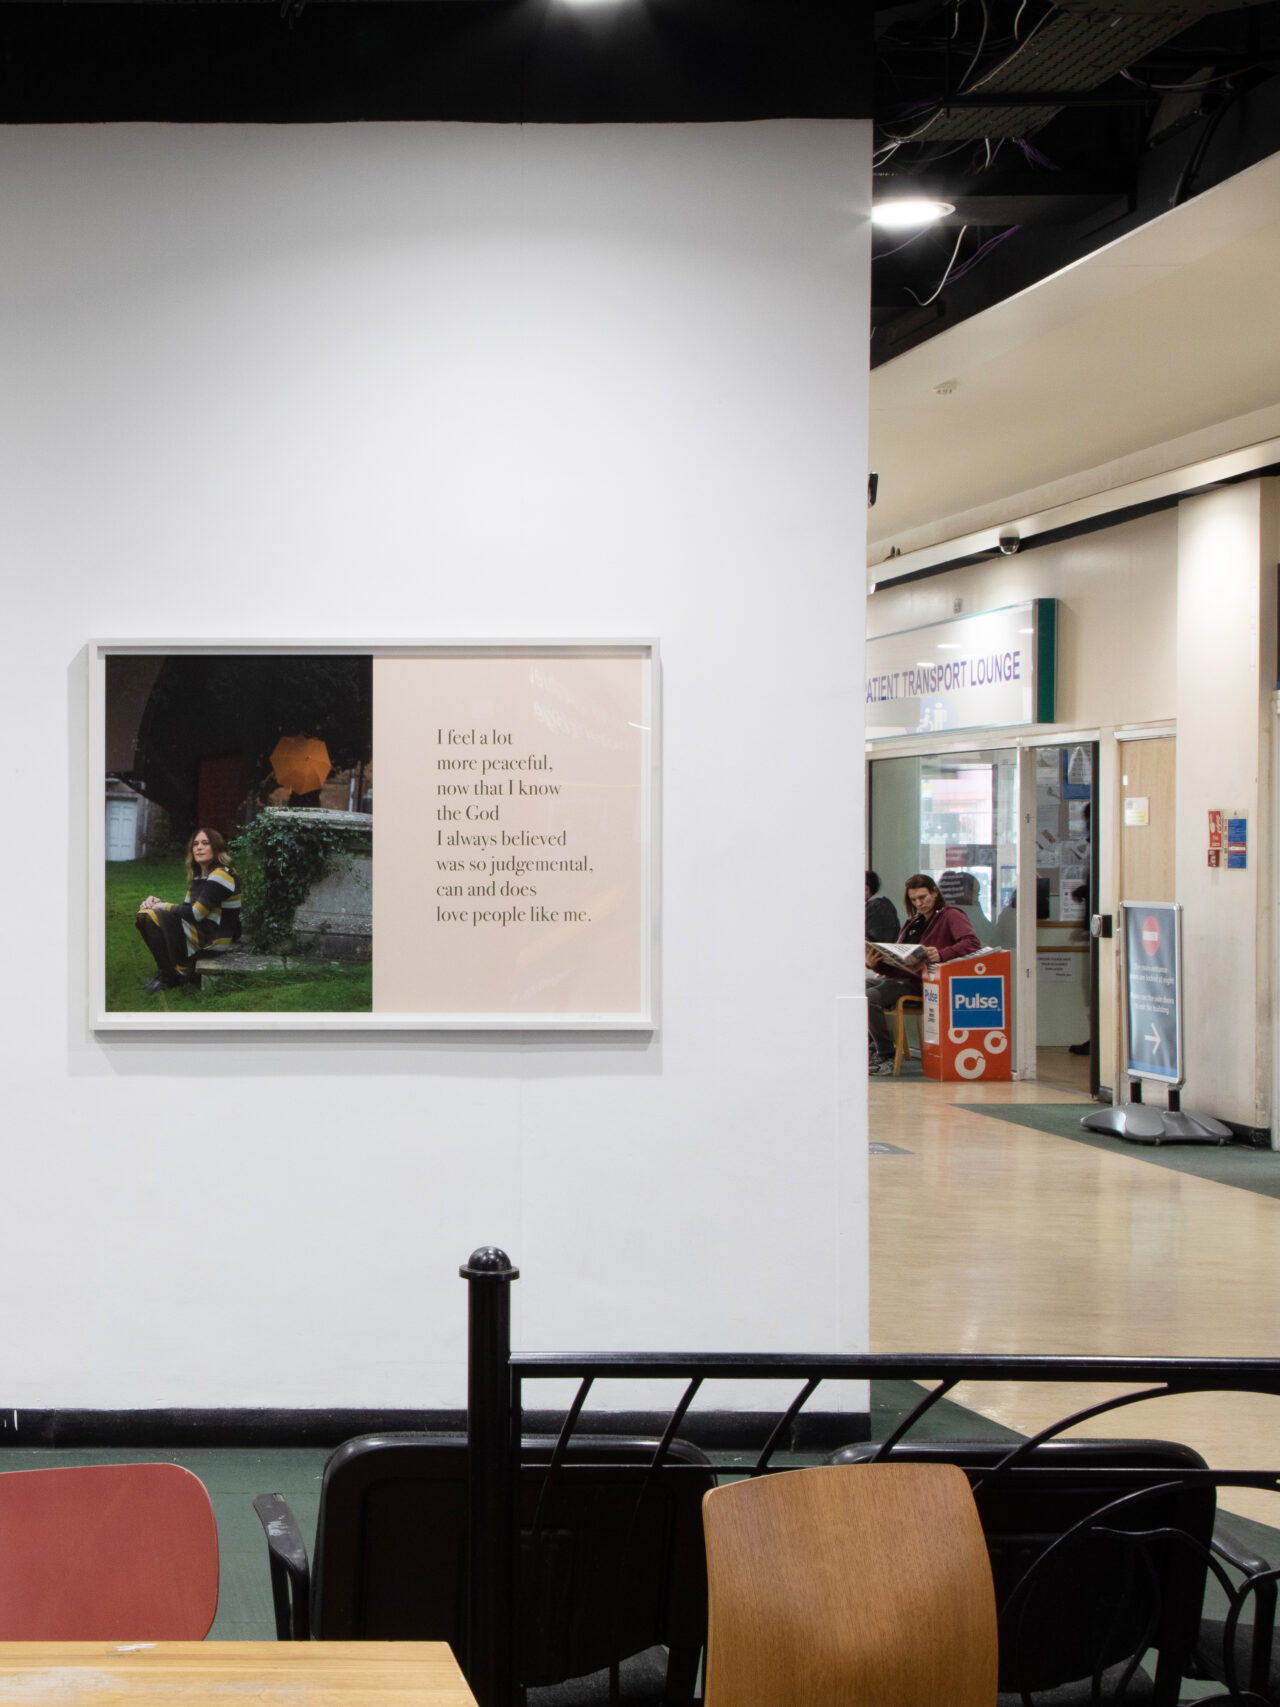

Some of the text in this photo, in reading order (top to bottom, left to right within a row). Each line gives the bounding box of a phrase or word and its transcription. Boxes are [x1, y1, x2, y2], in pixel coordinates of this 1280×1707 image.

[865, 651, 1020, 703] ATIENT TRANSPORT LOUNGE
[437, 728, 513, 746] I feel a lot
[436, 753, 553, 776] more peaceful,
[437, 779, 562, 796] now that I know
[436, 804, 499, 821] the God
[437, 829, 567, 852] I always believed
[435, 855, 594, 877] was so judgemental,
[436, 880, 537, 897] can and does
[436, 905, 592, 928] love people like me.
[924, 988, 938, 1003] Pulse
[954, 993, 999, 1009] Pulse
